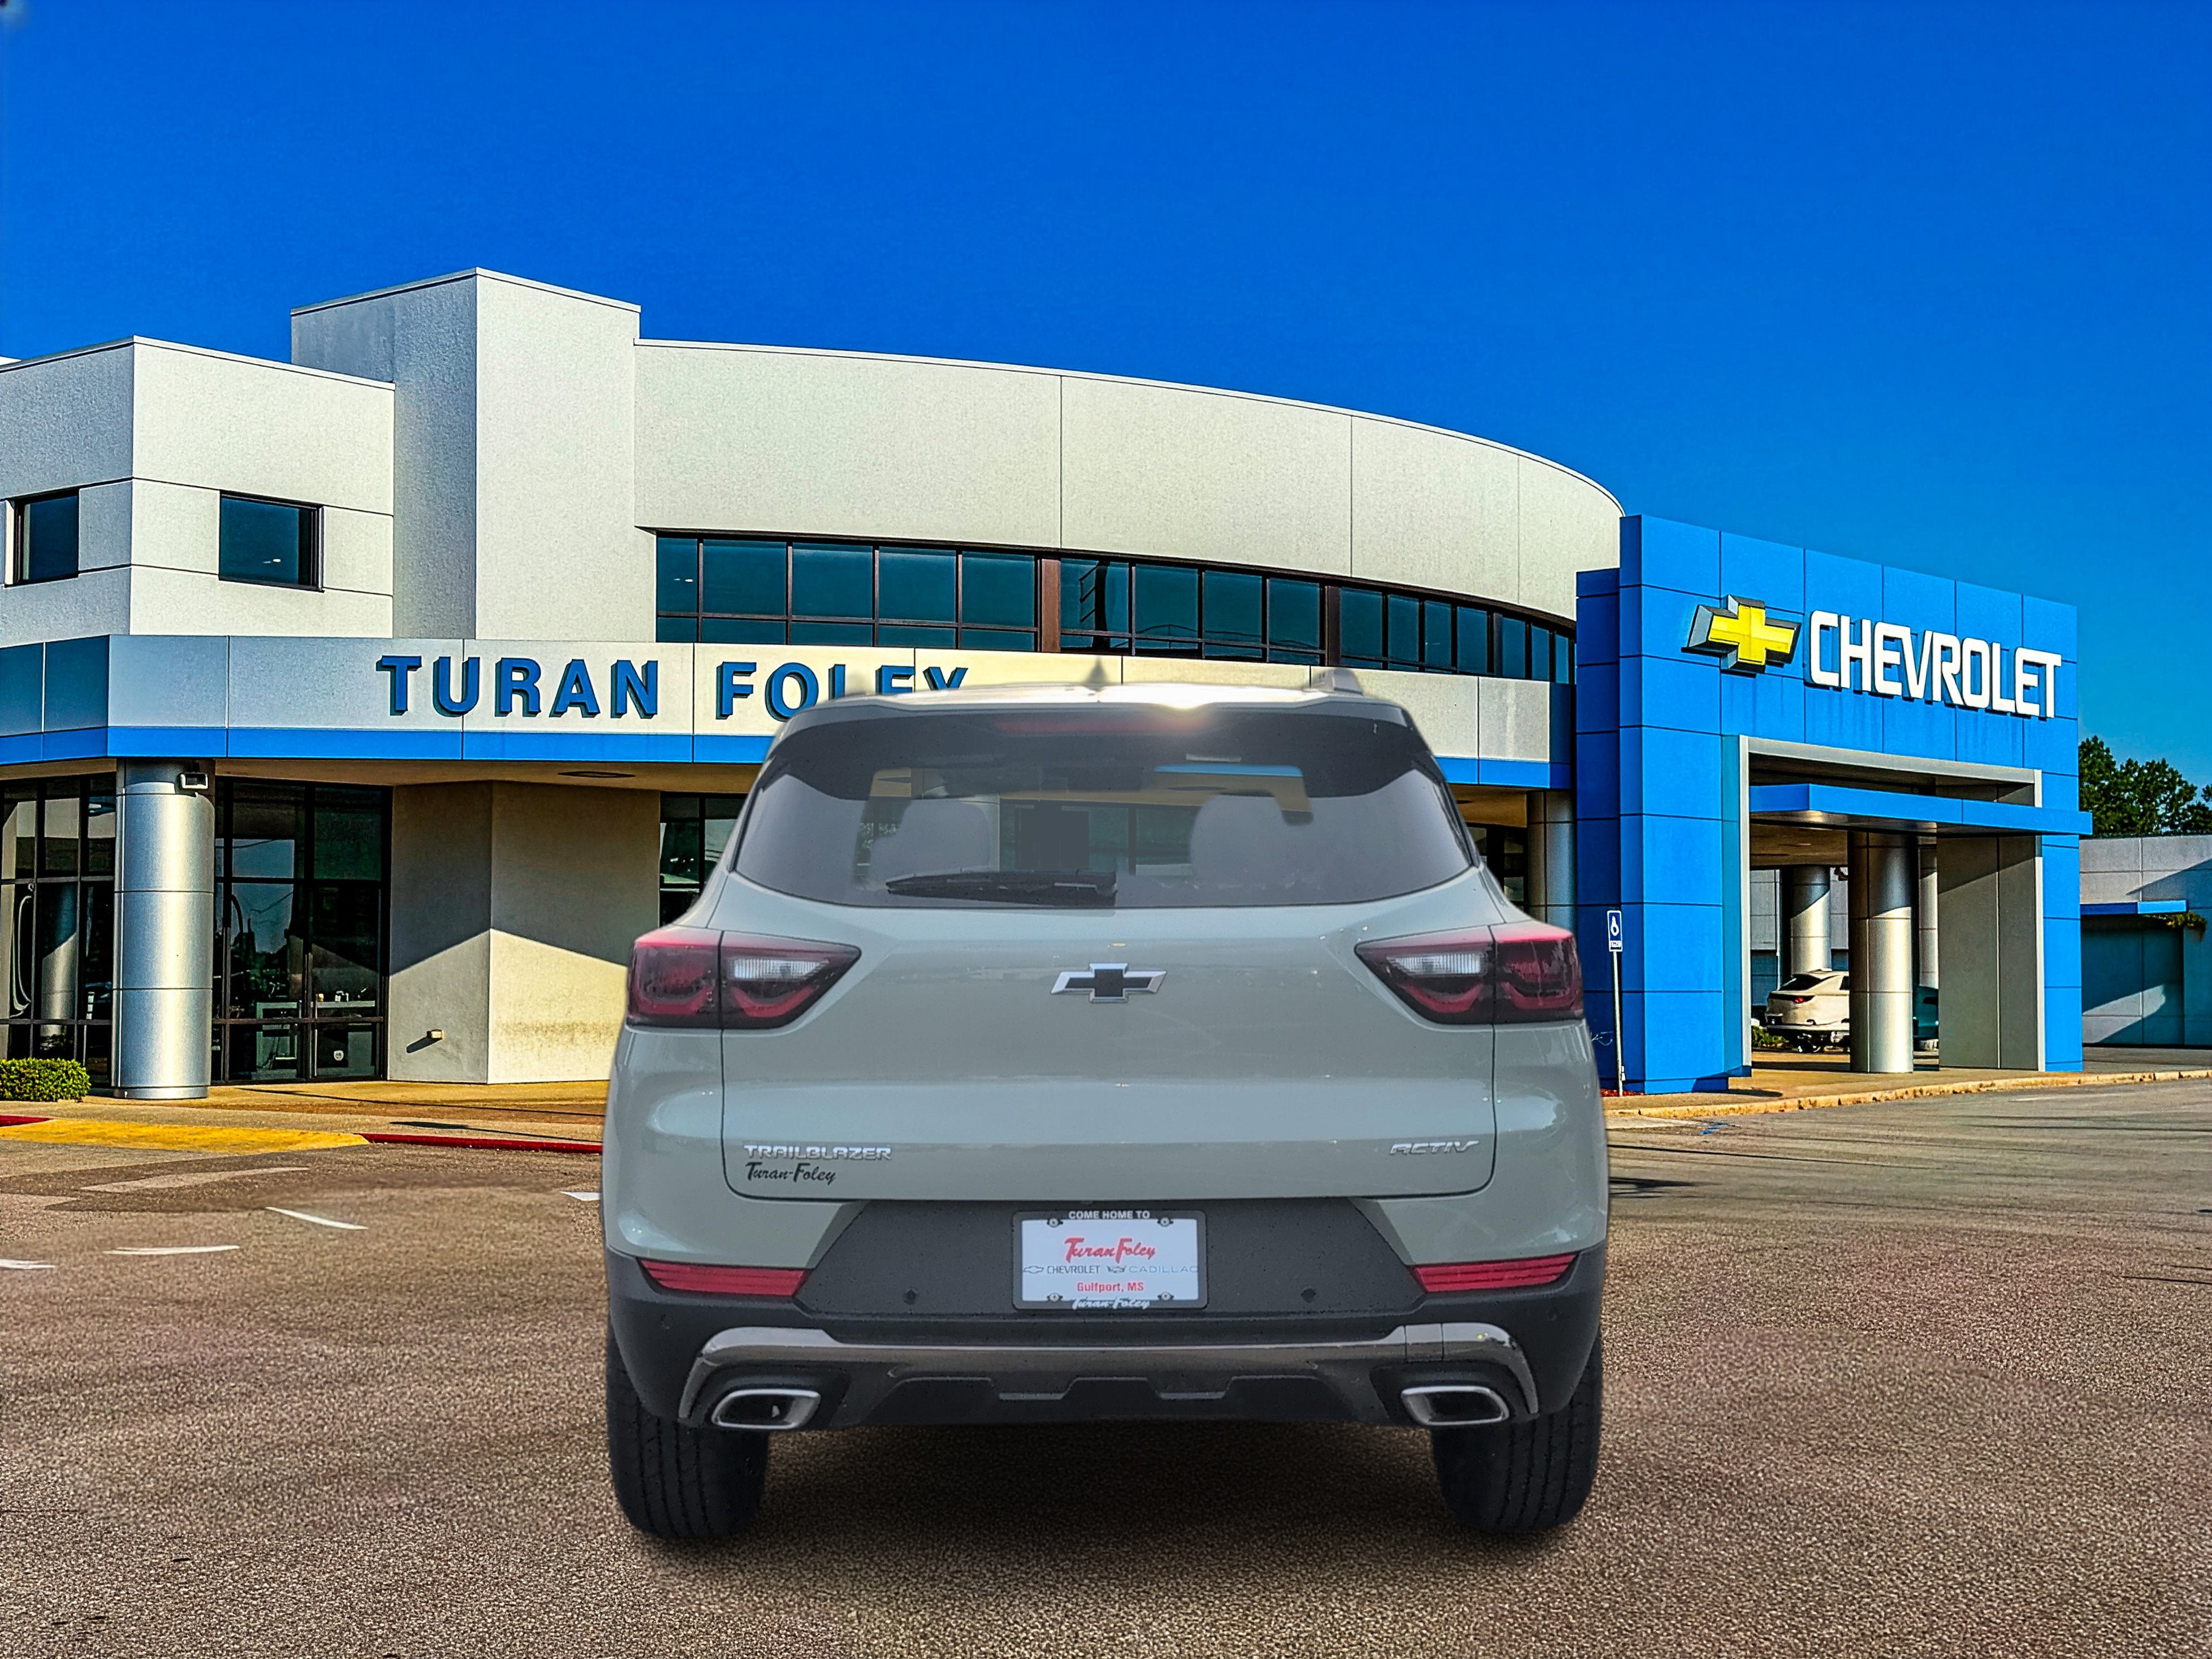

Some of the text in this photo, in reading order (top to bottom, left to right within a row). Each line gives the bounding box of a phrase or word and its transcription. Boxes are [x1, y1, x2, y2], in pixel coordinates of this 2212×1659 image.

[1809, 609, 2062, 719] CHEVROLET
[376, 655, 658, 719] TURAN
[743, 1144, 892, 1160] TRAILBLAZER
[1388, 1140, 1480, 1155] ACTIV
[1068, 1210, 1150, 1219] COME HOME TO
[1047, 1265, 1198, 1274] CHEVROLET CADILLAC
[1077, 1282, 1144, 1294] Gulfport, MS
